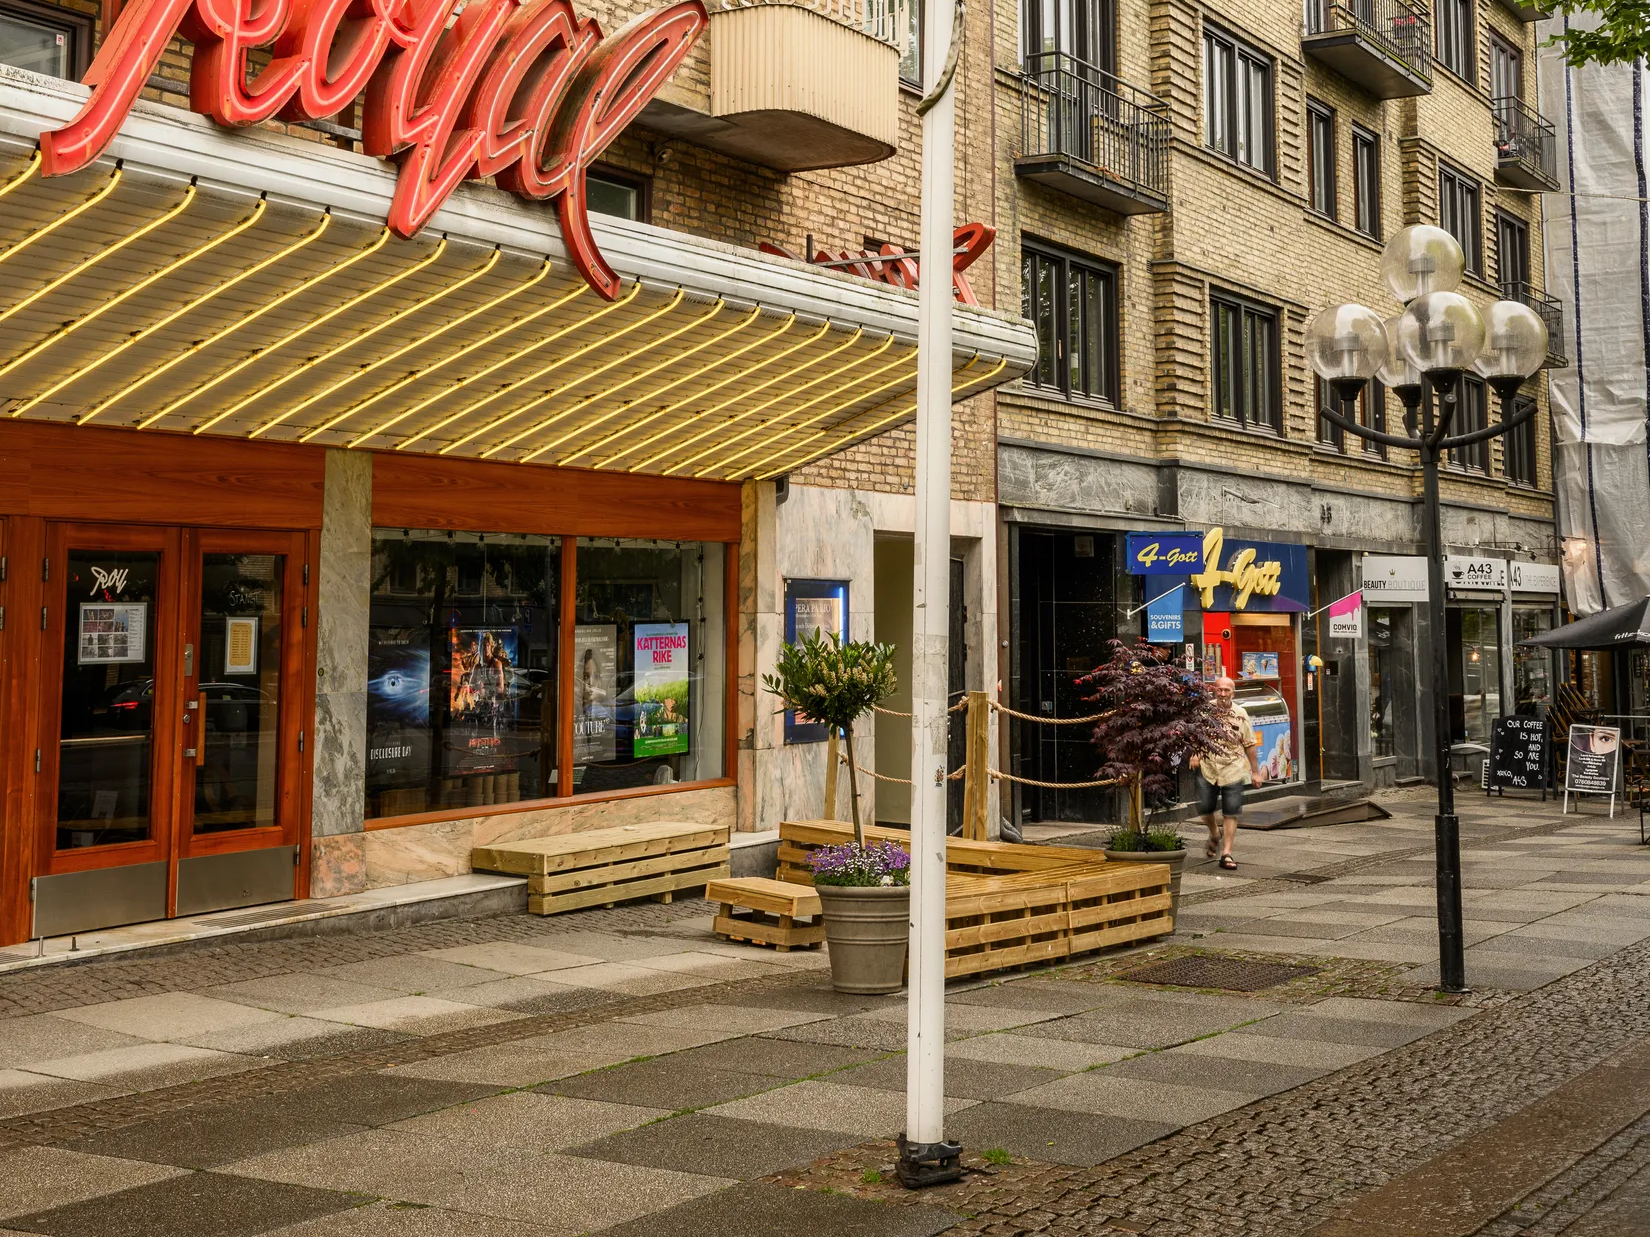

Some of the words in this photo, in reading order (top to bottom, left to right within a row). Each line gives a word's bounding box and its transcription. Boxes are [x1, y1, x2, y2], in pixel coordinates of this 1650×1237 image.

[1137, 542, 1198, 567] 4-Gott
[1191, 527, 1281, 610] 4-Gott
[1467, 563, 1493, 574] A43
[1363, 580, 1387, 589] BEAUTY
[1387, 579, 1425, 590] BOUTIQUE
[1333, 623, 1358, 631] COMVIQ
[636, 635, 687, 651] KATTERNAS
[652, 650, 672, 663] RIKE
[1506, 720, 1521, 728] OUR
[1523, 720, 1543, 730] COFFEE
[1520, 731, 1528, 740] IS
[1530, 733, 1543, 743] HOT,
[1527, 743, 1541, 751] AND
[1513, 750, 1524, 759] SO
[1527, 752, 1540, 761] ARE
[1525, 761, 1540, 771] YOU.
